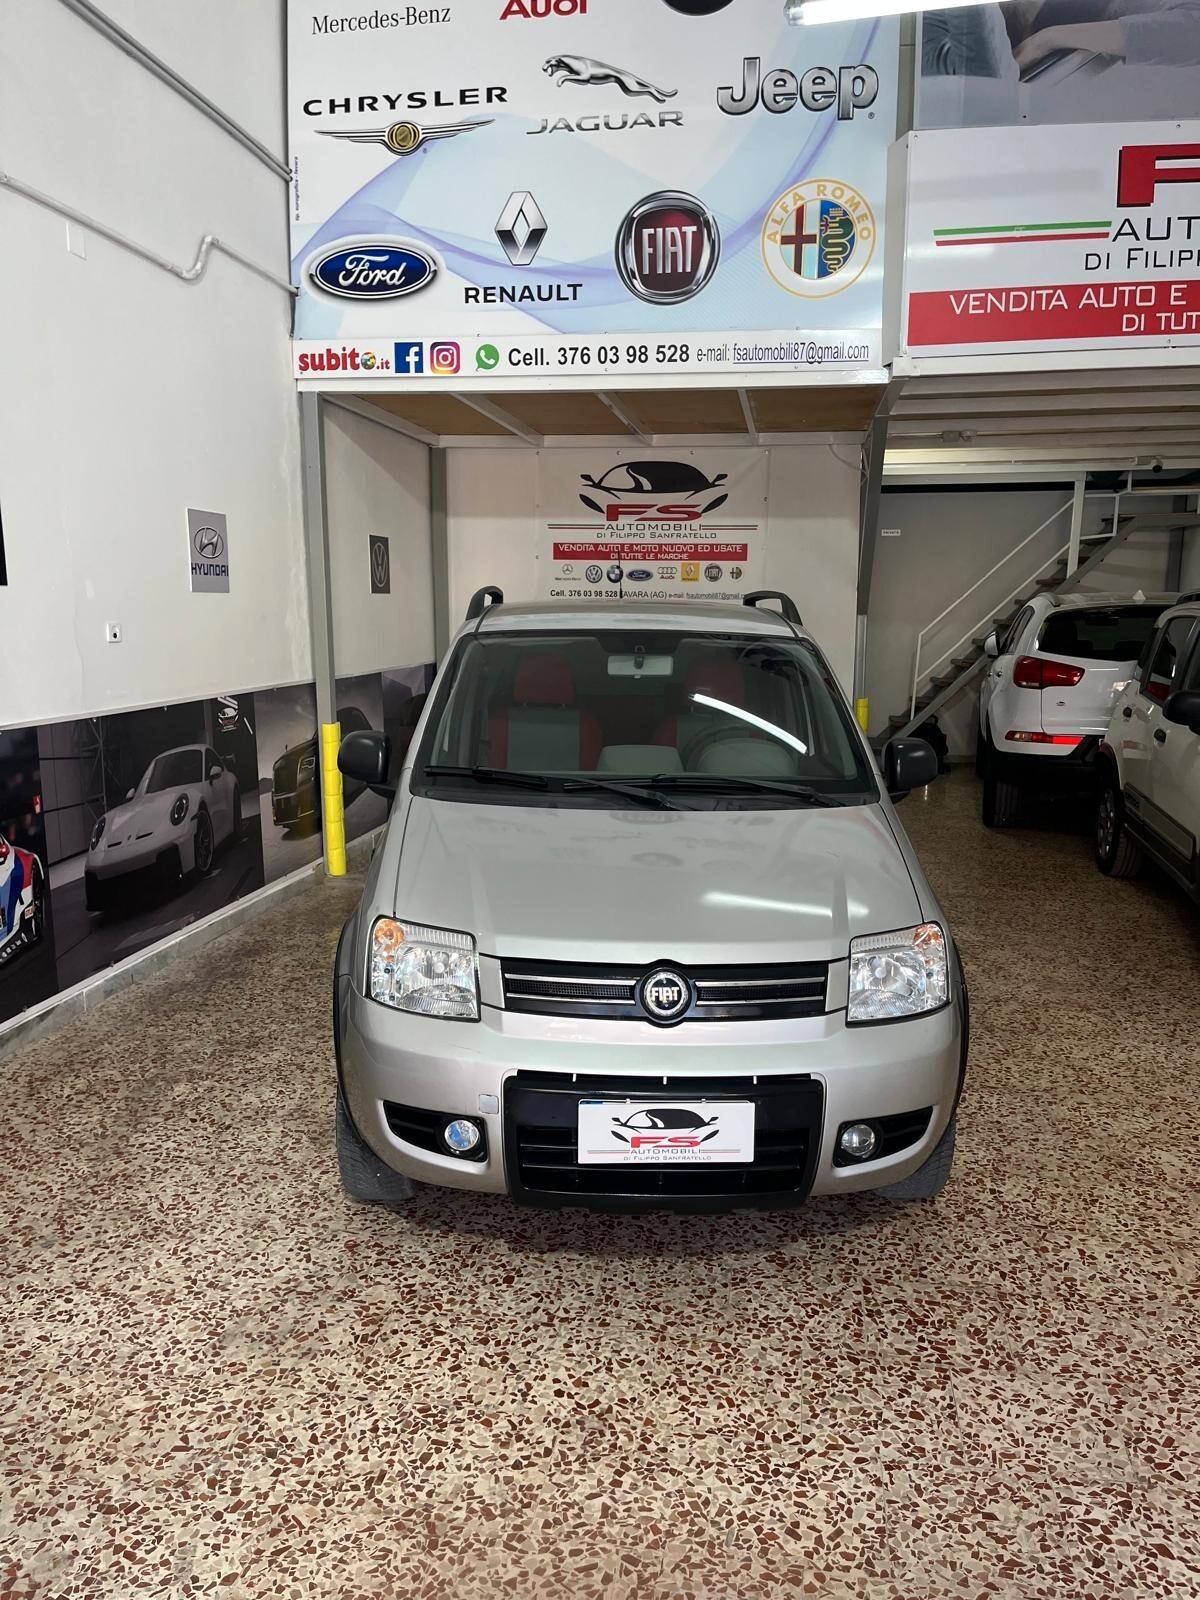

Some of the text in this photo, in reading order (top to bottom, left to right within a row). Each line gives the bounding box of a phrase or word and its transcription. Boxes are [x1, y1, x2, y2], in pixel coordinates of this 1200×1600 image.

[312, 6, 450, 35] Mercedes-Benz
[717, 57, 879, 120] Jeep
[303, 86, 508, 117] CHRYSLER
[526, 110, 684, 135] JAGUAR
[766, 182, 874, 244] ALFA ROMEO
[642, 225, 697, 275] FIAT
[1085, 247, 1200, 271] DI FILIP
[338, 254, 407, 287] Ford
[464, 283, 584, 304] RENAULT
[950, 284, 1188, 316] VENDITA AUTO E
[1122, 313, 1146, 332] DI
[508, 340, 870, 367] Cell. 376 03 98 528 e-mail: fsautomobili87@gmail.com
[606, 504, 702, 521] FS
[191, 562, 229, 577] HYUNDAI
[650, 591, 668, 599] (AG)
[651, 986, 680, 1002] FIAT
[630, 1136, 701, 1149] FS
